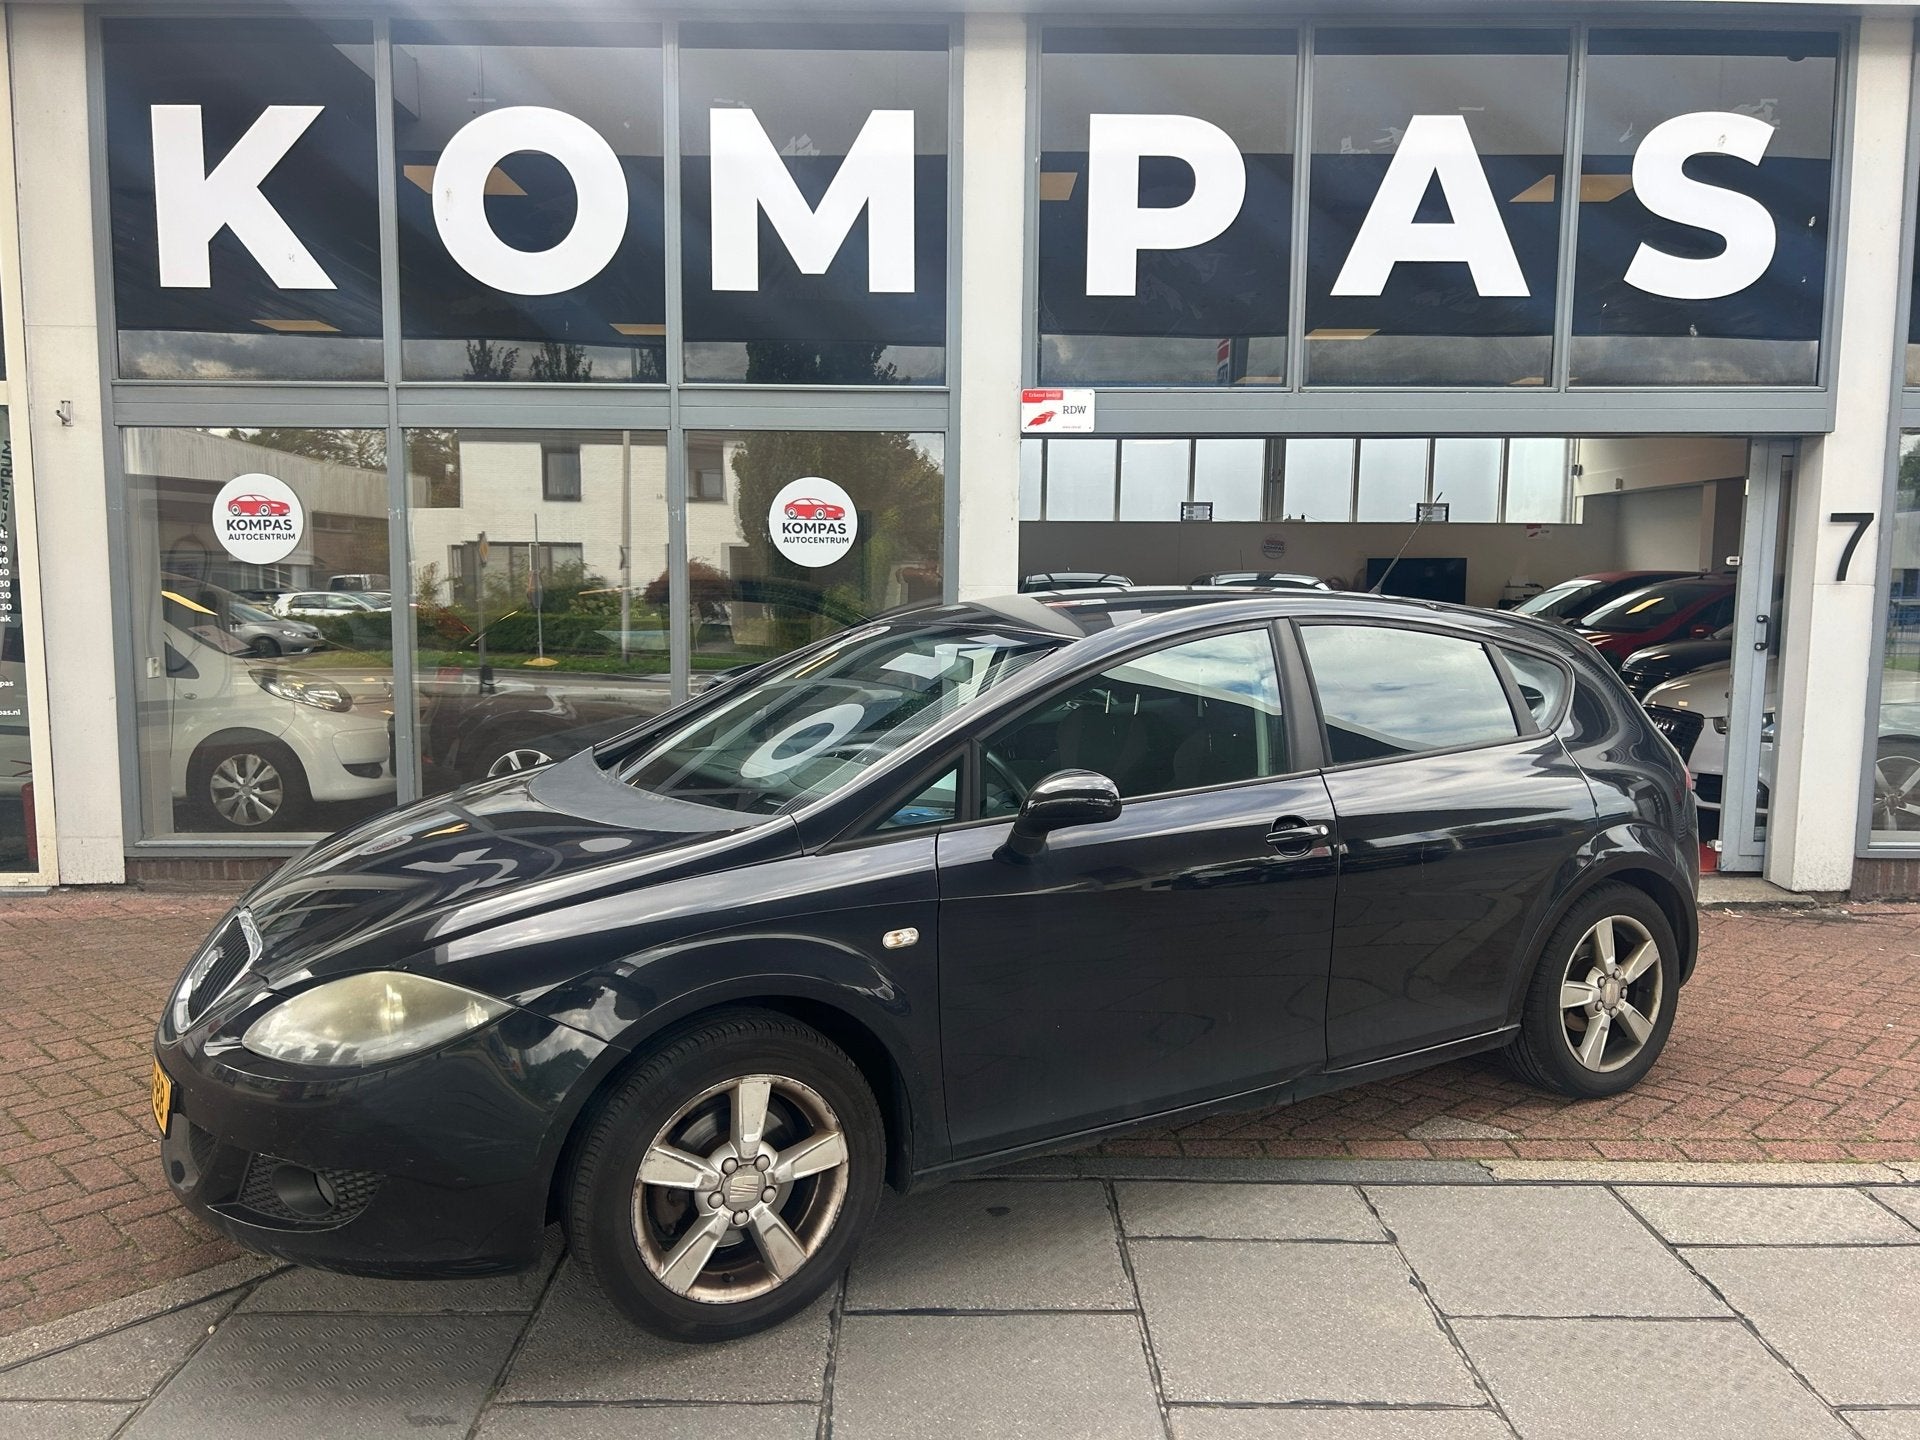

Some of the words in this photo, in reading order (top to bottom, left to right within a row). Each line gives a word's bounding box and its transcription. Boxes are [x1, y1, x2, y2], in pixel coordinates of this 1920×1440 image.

[150, 104, 1777, 299] KOMPAS
[1062, 405, 1087, 415] RDW
[226, 519, 293, 531] KOMPAS
[782, 522, 847, 535] KOMPAS
[228, 533, 296, 541] AUTOCENTRUM
[783, 536, 849, 544] AUTOCENTRUM
[1829, 512, 1874, 582] 7
